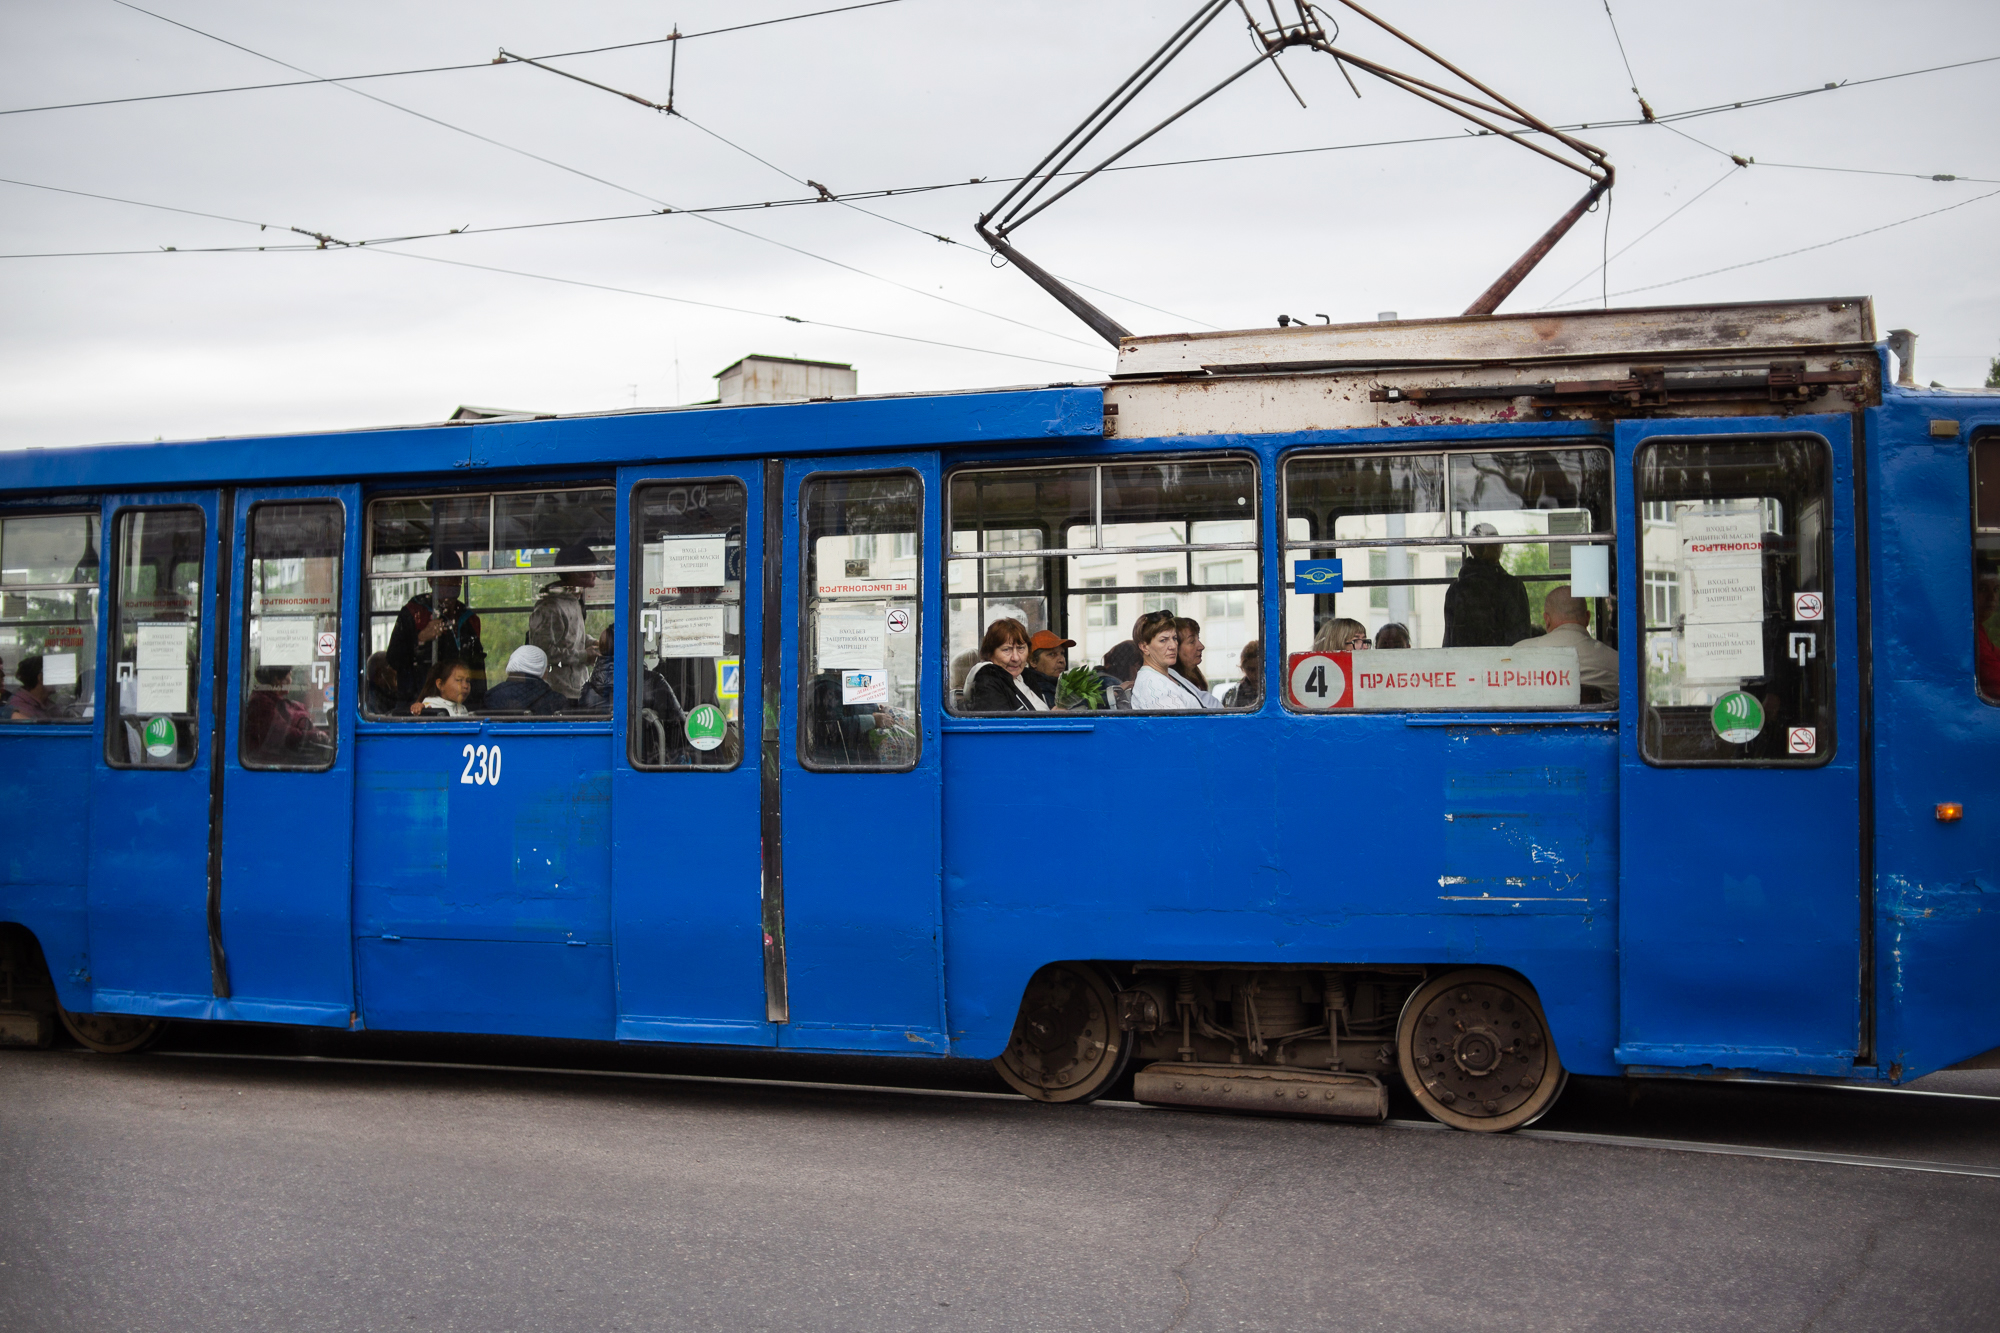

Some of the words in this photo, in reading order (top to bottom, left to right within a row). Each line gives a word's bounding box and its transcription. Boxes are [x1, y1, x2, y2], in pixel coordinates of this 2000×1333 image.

[1690, 533, 1728, 541] ЗАЩИТНОЙ
[669, 554, 700, 562] ЗАЩИТНОЙ
[1692, 587, 1730, 595] ЗАЩИТНОЙ
[1731, 585, 1756, 593] МАСКИ
[1706, 595, 1742, 603] ЗАПРЕЩЕН
[1692, 640, 1730, 648] ЗАЩИТНОЙ
[1731, 639, 1756, 647] МАСКИ
[1305, 665, 1328, 698] 4
[461, 744, 501, 786] 230
